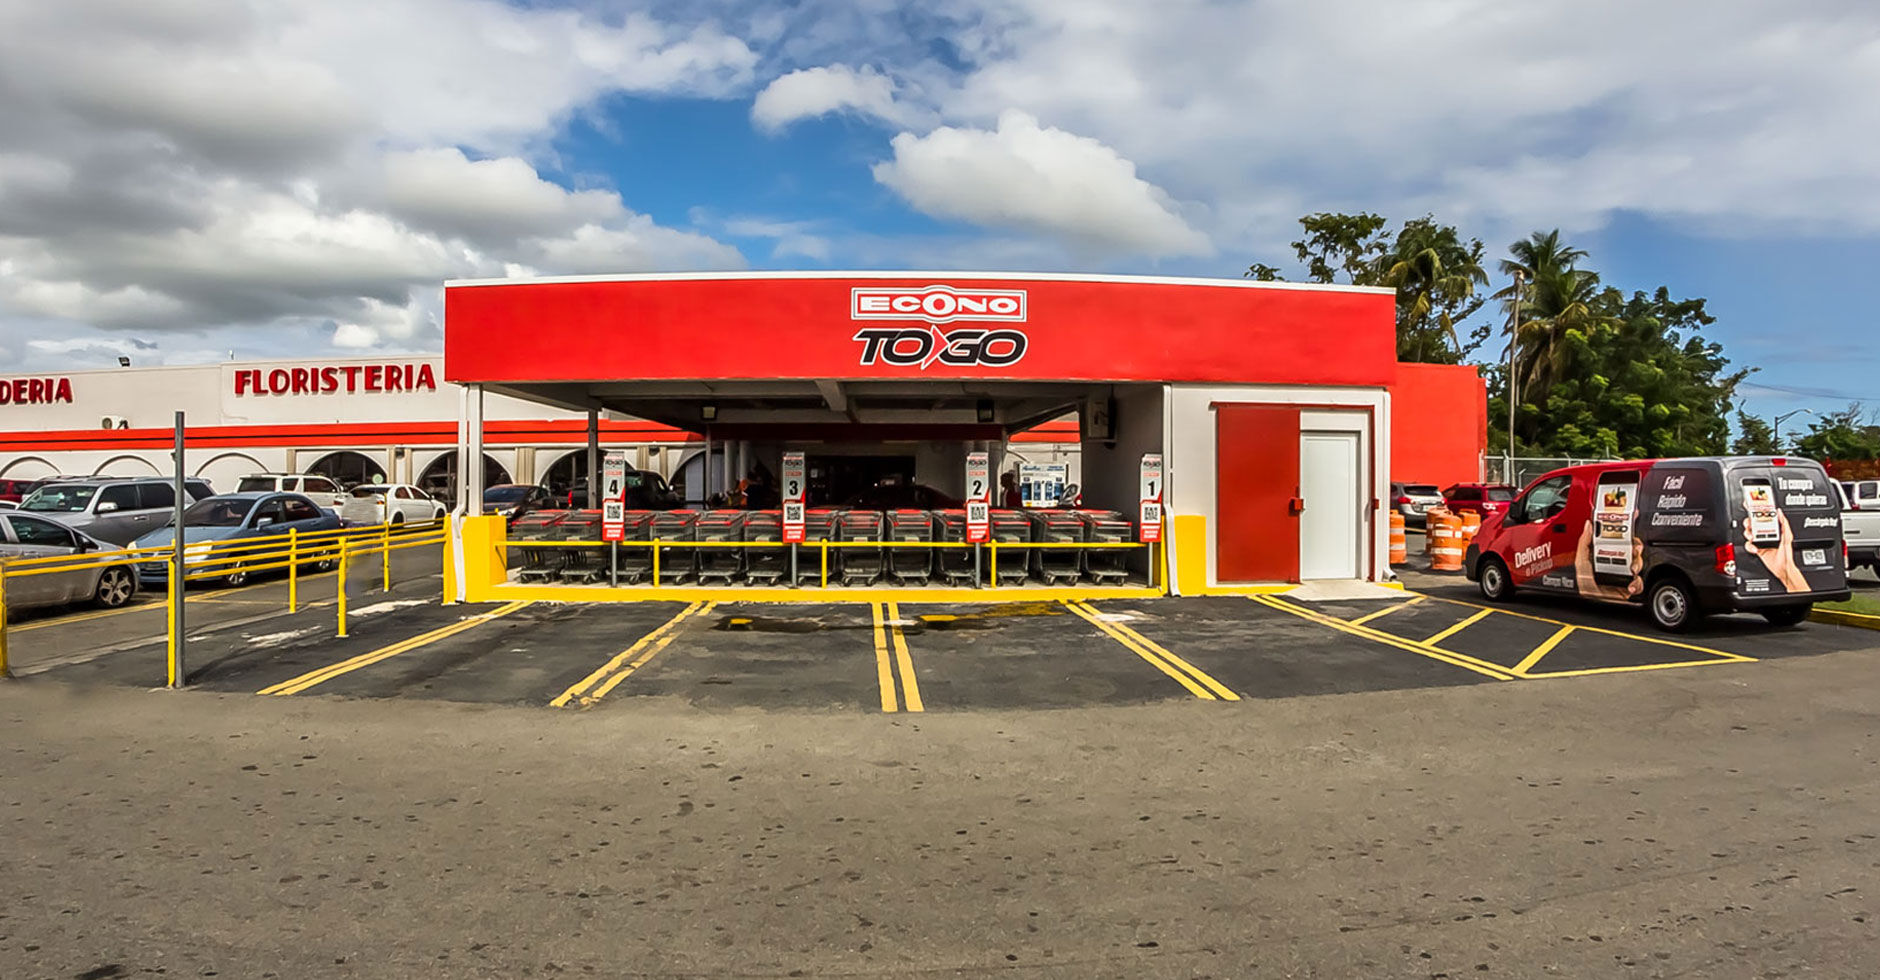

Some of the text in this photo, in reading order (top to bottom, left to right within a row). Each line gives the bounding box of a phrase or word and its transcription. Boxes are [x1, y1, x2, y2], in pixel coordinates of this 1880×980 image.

[860, 293, 1018, 315] ECONO
[235, 364, 436, 396] FLORISTERIA
[609, 480, 618, 495] 4
[789, 481, 798, 496] 3
[973, 480, 982, 495] 2
[1148, 481, 1155, 496] 1
[1662, 475, 1686, 490] Fácil
[1657, 494, 1687, 510] Rápido
[1651, 512, 1703, 527] Conveniente
[1514, 541, 1552, 568] Delivery
